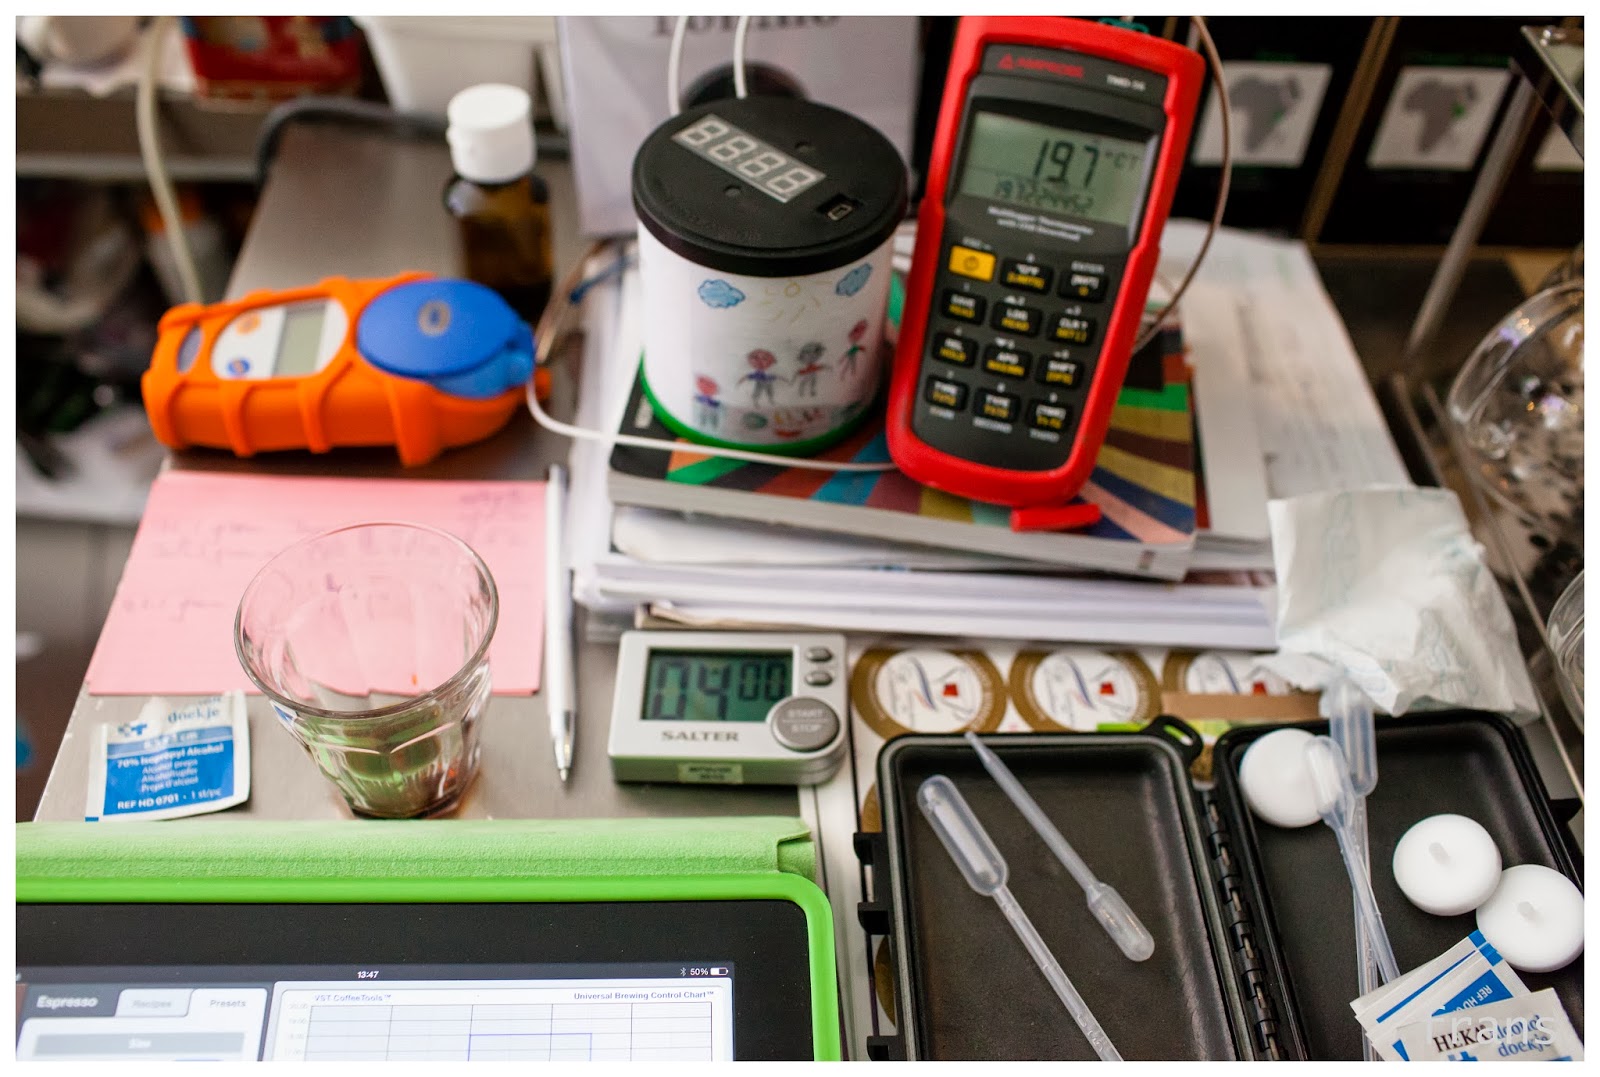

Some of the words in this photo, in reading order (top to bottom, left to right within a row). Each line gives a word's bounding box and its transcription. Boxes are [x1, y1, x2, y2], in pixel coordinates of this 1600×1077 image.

[661, 730, 740, 742] SALTER
[186, 742, 224, 758] Alcohol
[117, 800, 136, 811] REF
[138, 797, 155, 808] HD
[155, 793, 180, 807] 0701
[357, 970, 380, 980] 13:47
[690, 967, 708, 976] 50%
[314, 994, 332, 1002] VST
[574, 992, 613, 1001] Universal
[614, 992, 649, 1001] Brewing
[650, 990, 682, 1000] Control
[1477, 984, 1494, 1001] REF
[36, 994, 99, 1010] Espresso
[210, 999, 247, 1008] Presets
